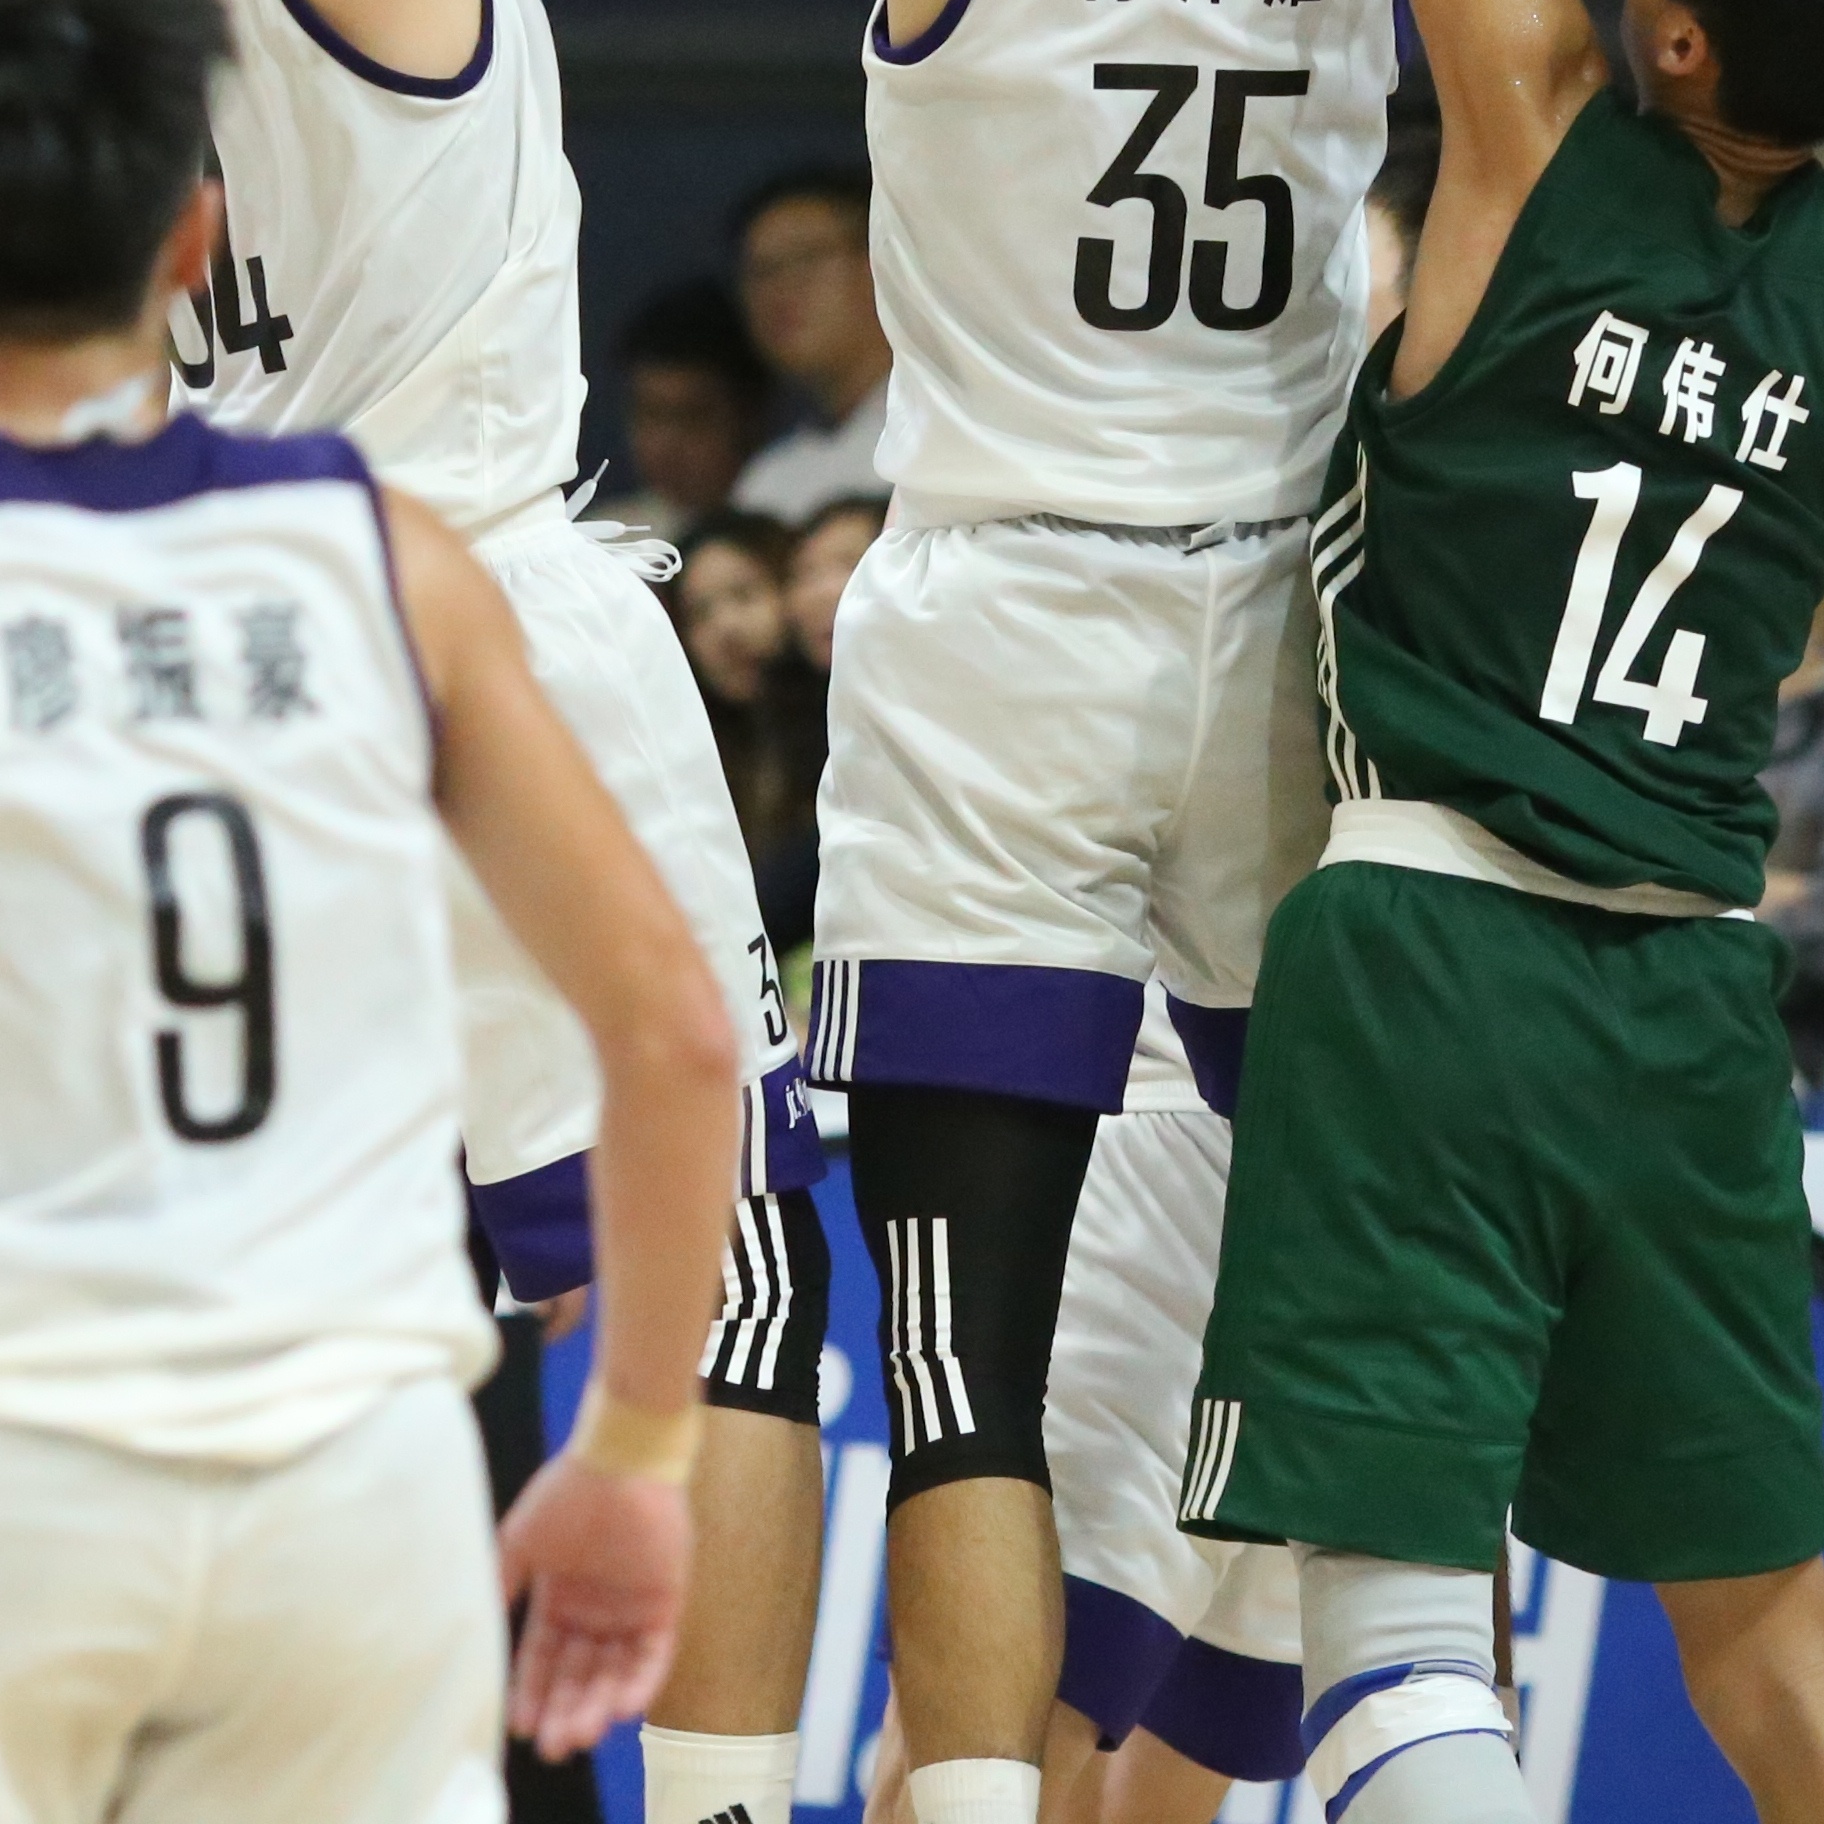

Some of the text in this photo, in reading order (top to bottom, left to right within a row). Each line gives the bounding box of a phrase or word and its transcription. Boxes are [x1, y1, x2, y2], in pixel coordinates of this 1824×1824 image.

[1074, 63, 1311, 331] 35
[1567, 310, 1809, 471] 何伟仕
[1539, 461, 1744, 747] 14
[140, 791, 277, 1145] 9
